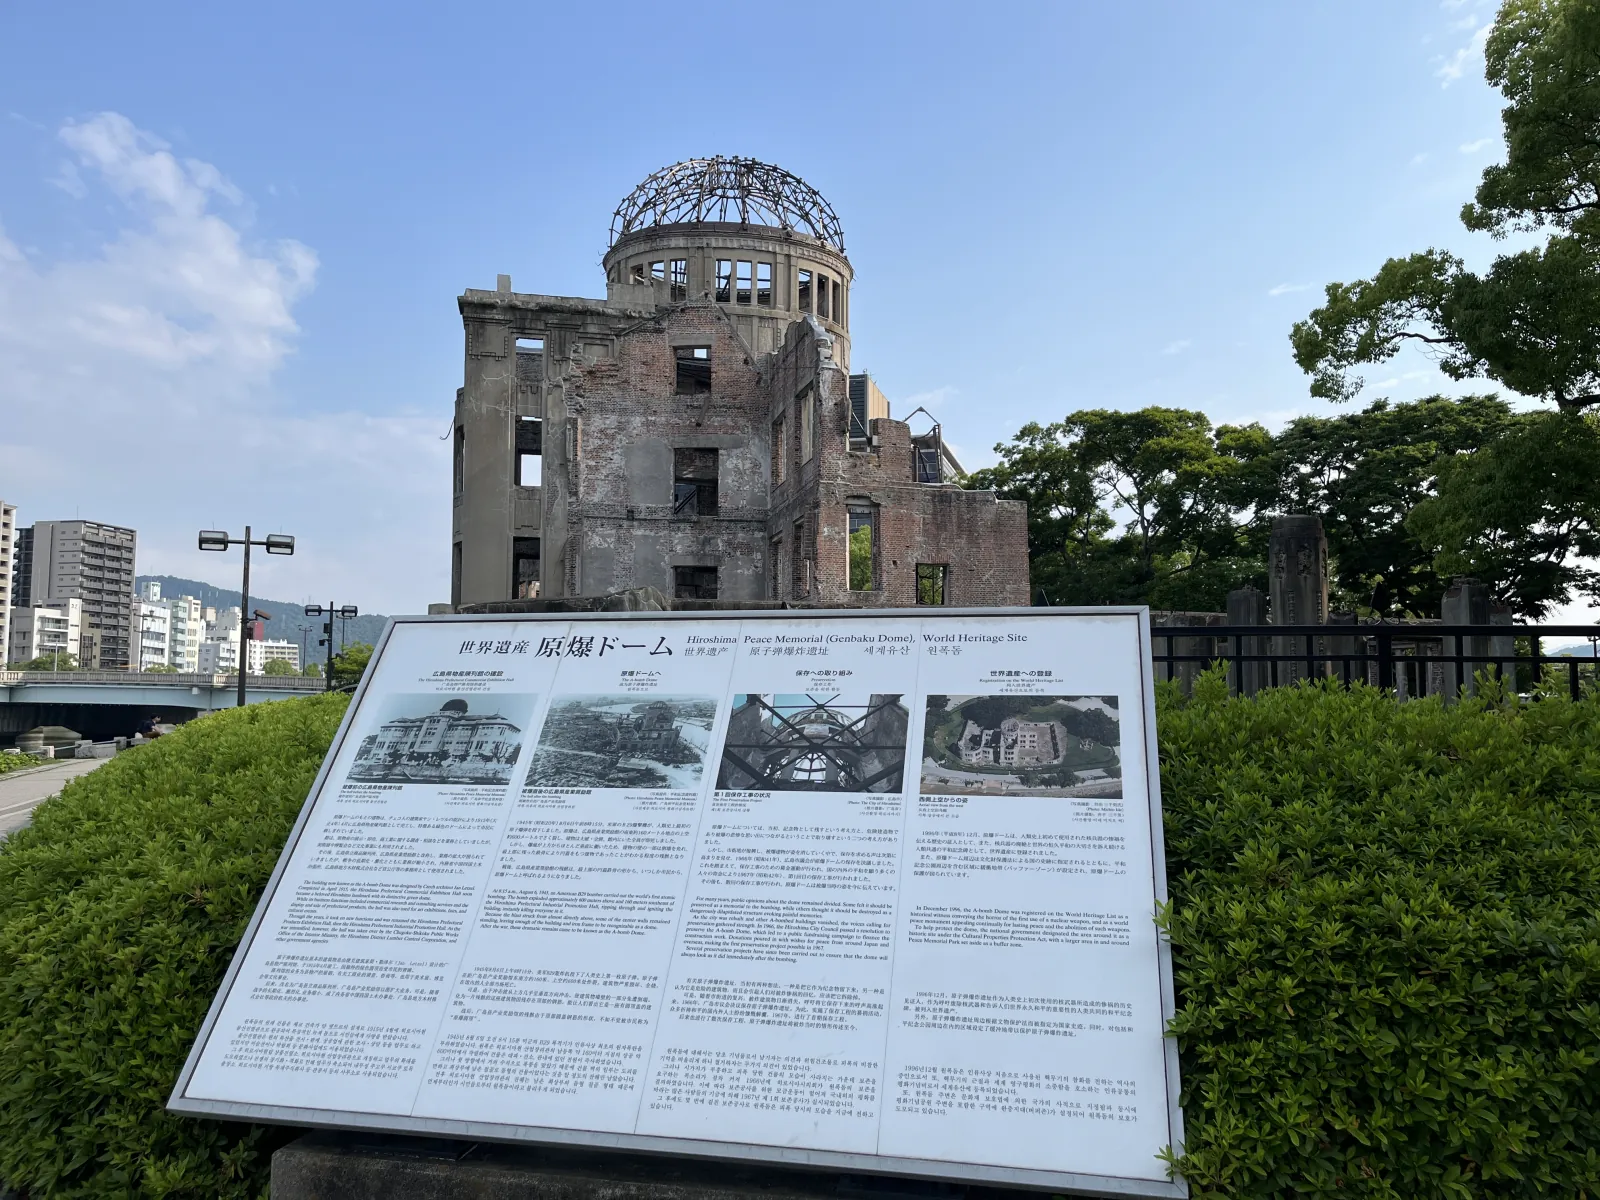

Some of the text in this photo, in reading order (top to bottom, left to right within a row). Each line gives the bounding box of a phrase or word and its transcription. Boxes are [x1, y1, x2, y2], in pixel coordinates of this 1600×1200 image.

[686, 634, 1028, 644] Hiroshima Peace Memorial (Genbaku Dome), World Heritage Site
[458, 636, 674, 658] 世界遺産 原爆ドーム
[684, 646, 830, 656] 世界遗产 原子弹爆炸遗址
